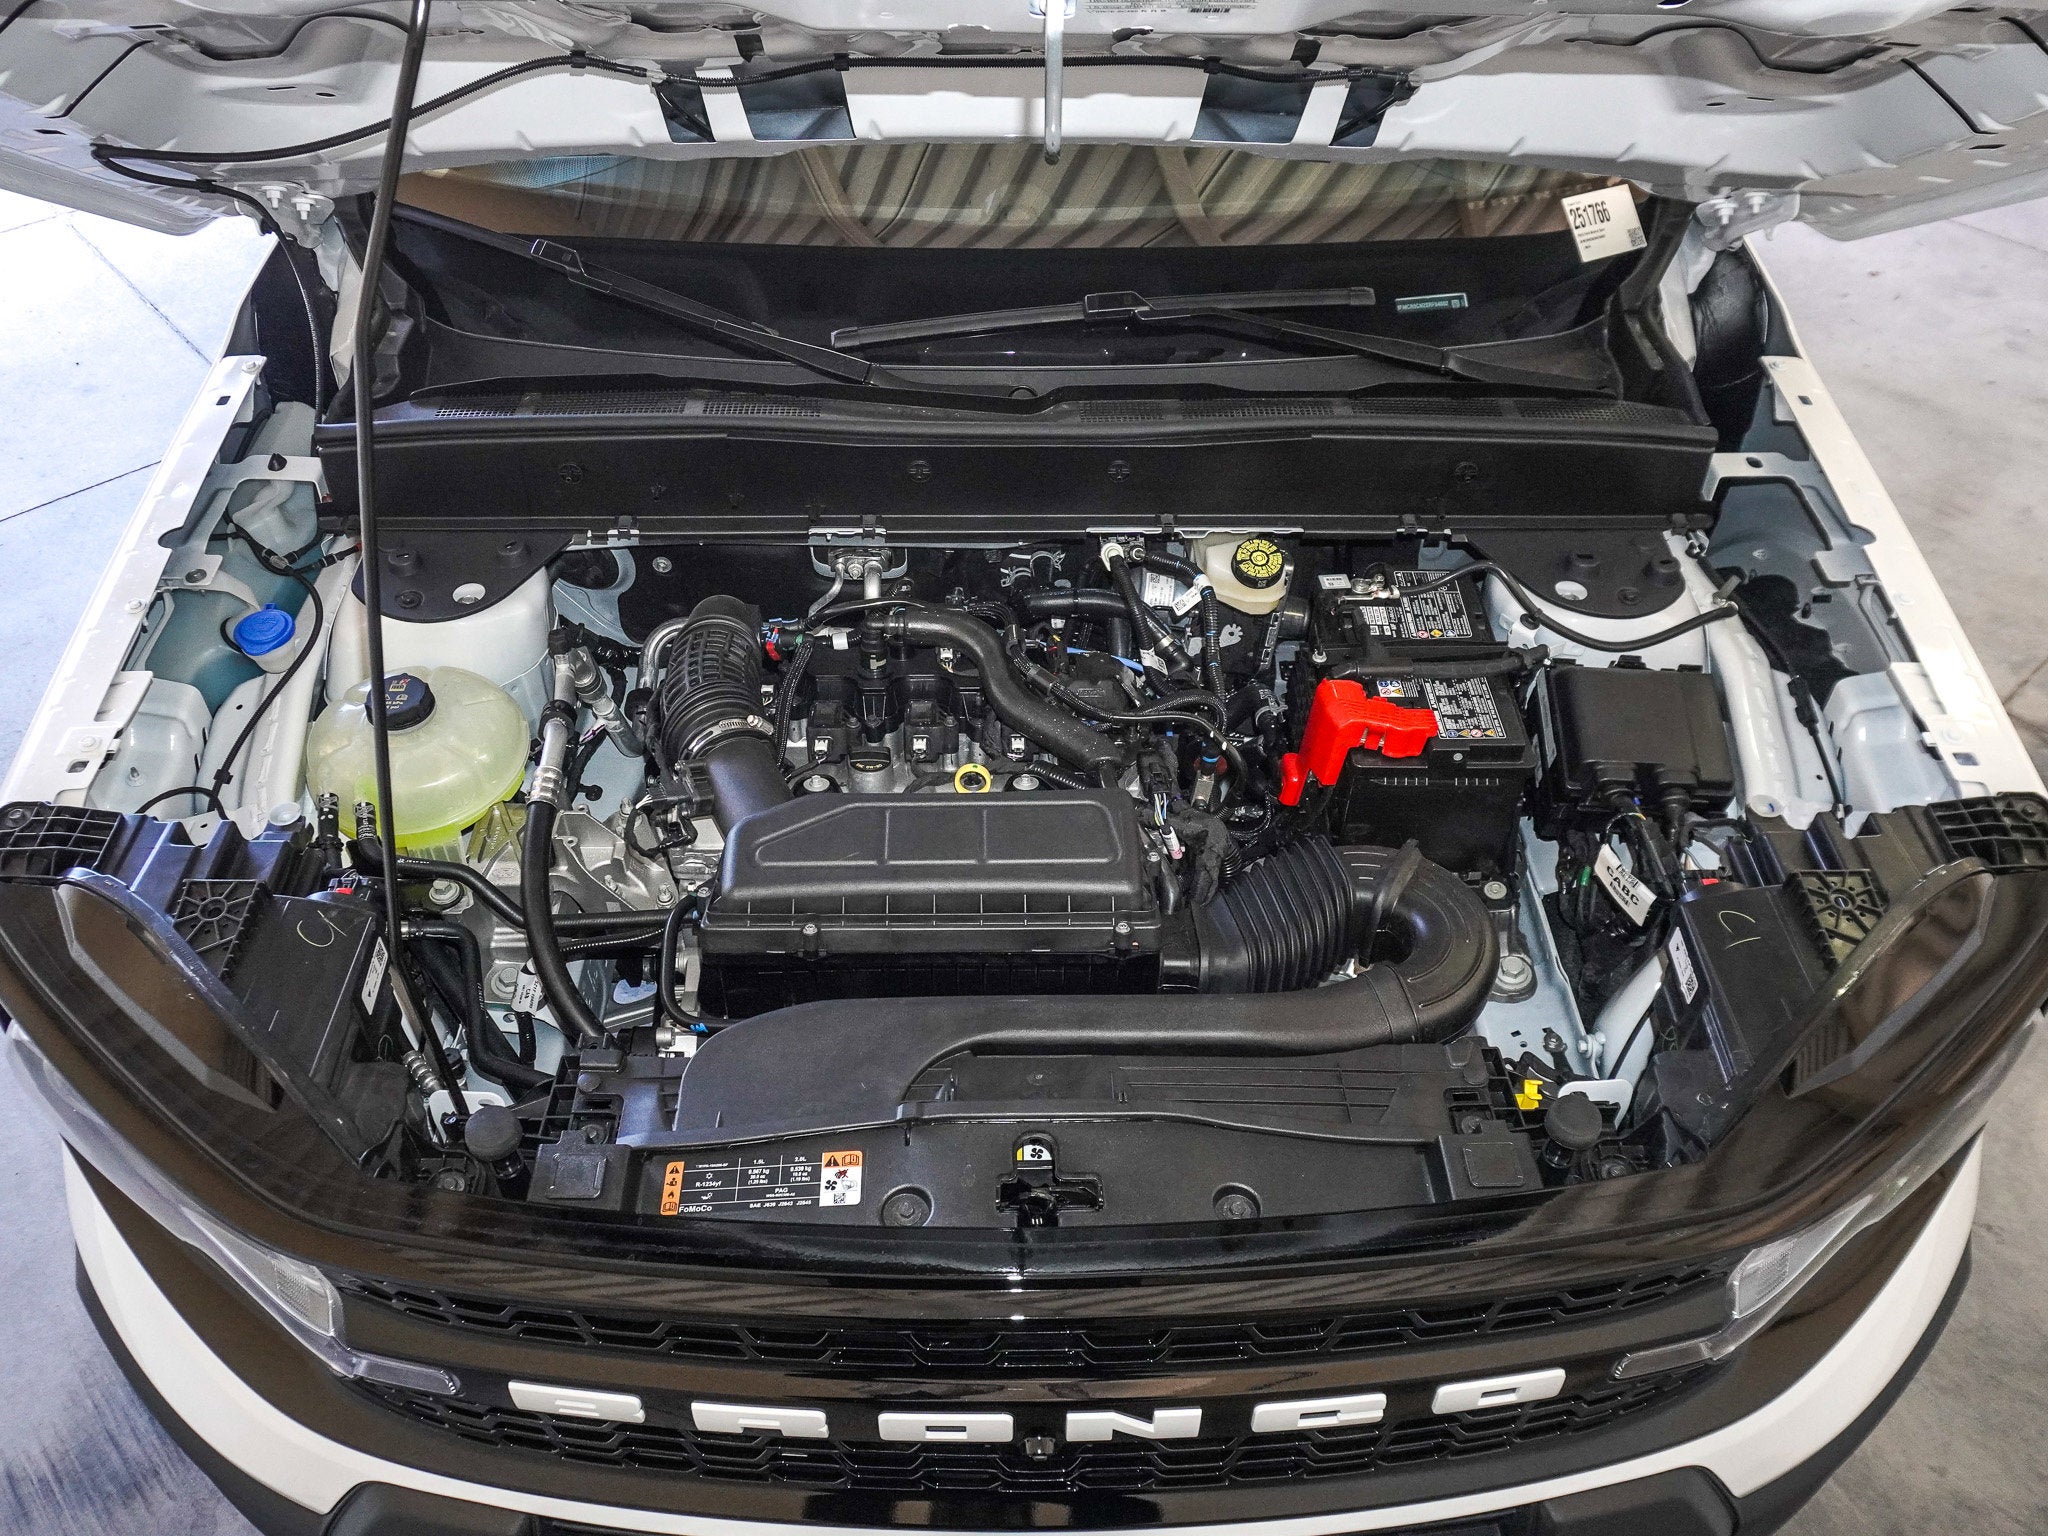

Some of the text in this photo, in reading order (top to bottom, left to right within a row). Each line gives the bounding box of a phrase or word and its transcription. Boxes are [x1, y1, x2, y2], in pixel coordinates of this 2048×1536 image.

[1570, 201, 1611, 230] 251766
[1606, 865, 1640, 906] CABC
[695, 1180, 722, 1188] R-1234yf
[678, 1204, 713, 1213] FoMoCo
[508, 1367, 1567, 1442] BRONCO
